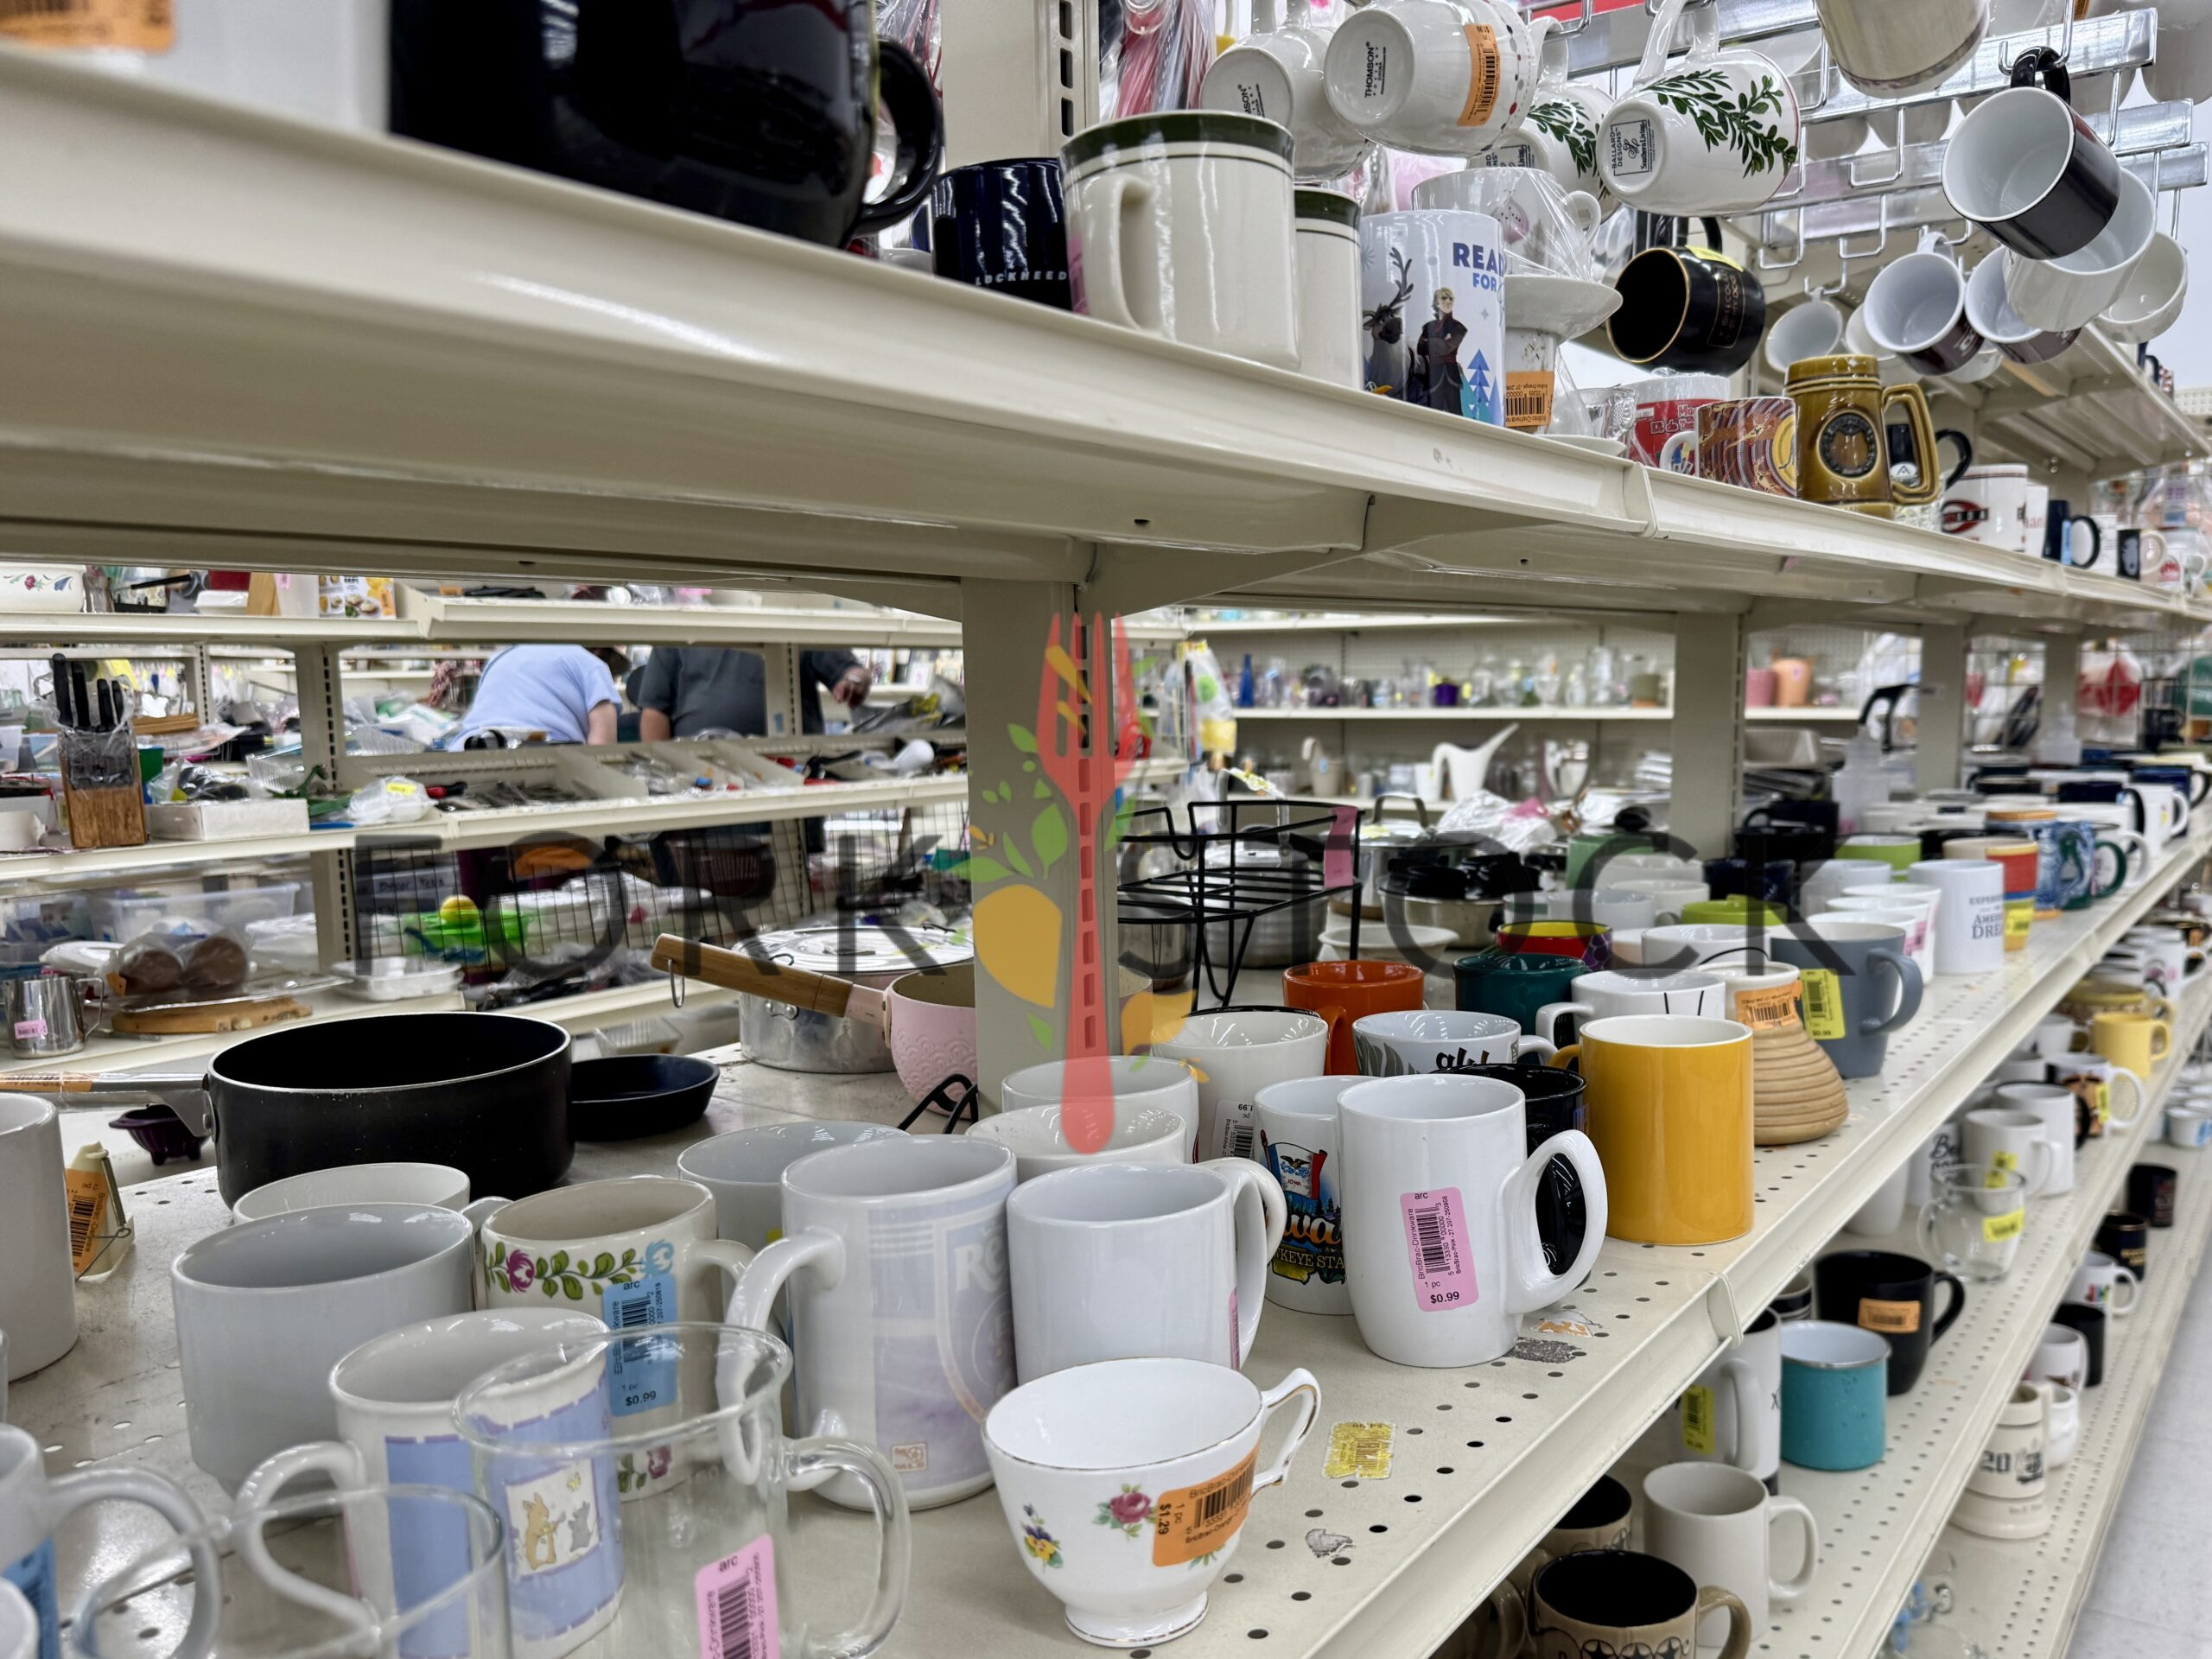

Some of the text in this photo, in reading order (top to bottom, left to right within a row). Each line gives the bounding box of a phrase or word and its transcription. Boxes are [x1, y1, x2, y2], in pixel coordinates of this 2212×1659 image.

[1472, 273, 1497, 292] FOR
[1287, 1179, 1301, 1187] IOWA
[1414, 1192, 1429, 1200] arc
[1408, 1208, 1426, 1280] BricBrac-Drinkware
[624, 1281, 641, 1291] arc
[1431, 1281, 1441, 1289] pc
[1430, 1291, 1460, 1305] $0.99
[626, 1390, 657, 1407] $0.99
[1159, 1503, 1172, 1535] $1.29
[1173, 1512, 1182, 1524] pc
[719, 1555, 738, 1573] arc
